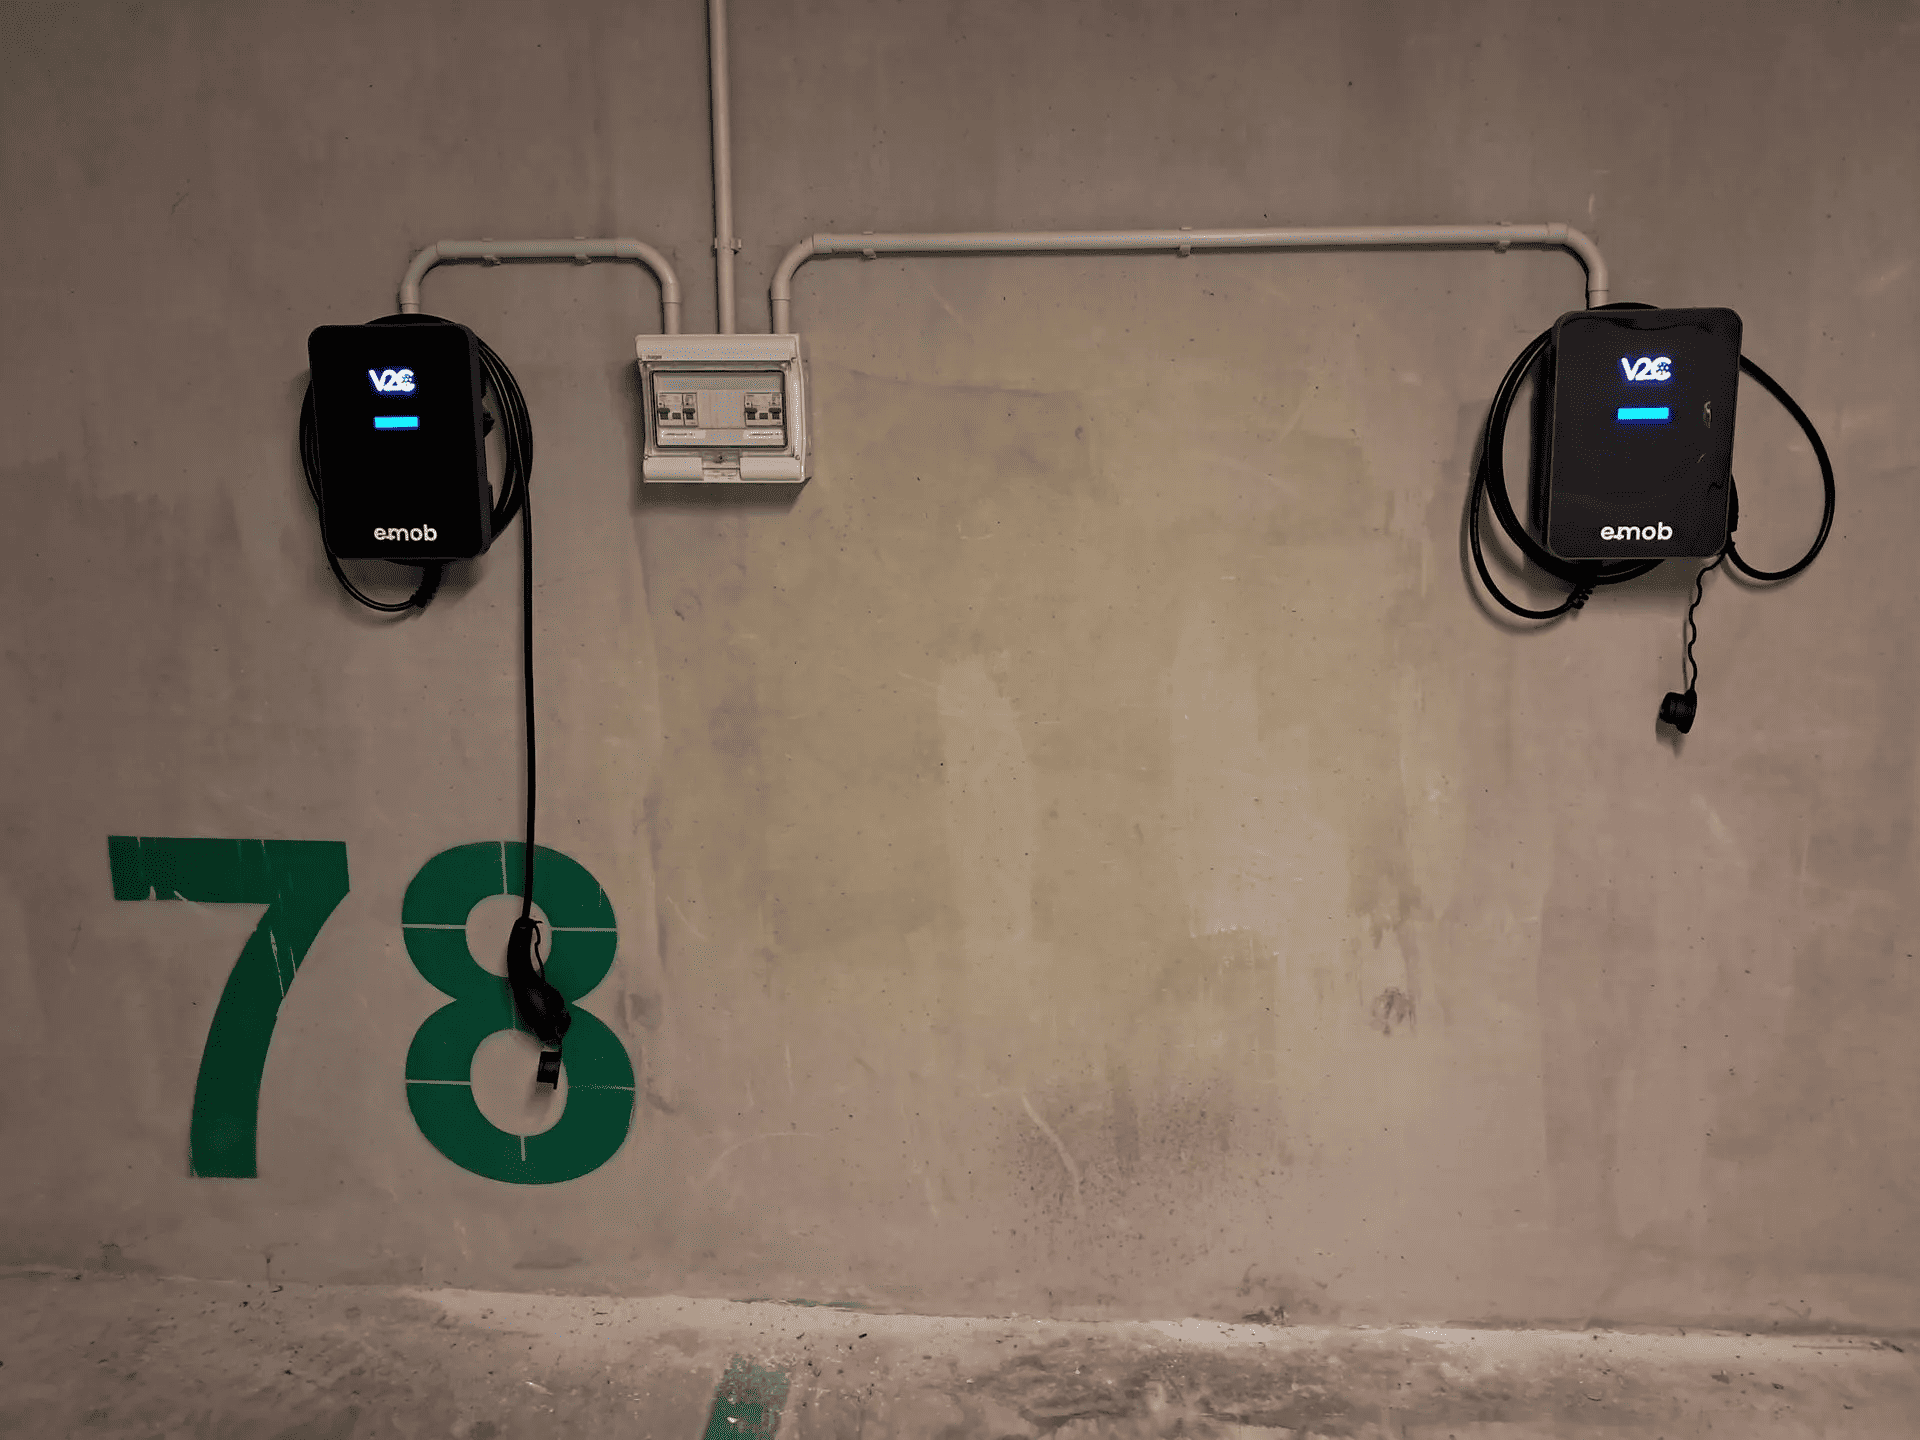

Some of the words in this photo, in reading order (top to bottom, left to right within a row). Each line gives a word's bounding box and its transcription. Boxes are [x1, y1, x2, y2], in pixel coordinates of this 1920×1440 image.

[1621, 356, 1672, 381] V2C
[368, 369, 415, 392] V2C
[373, 523, 438, 542] emob
[1600, 521, 1673, 541] emob
[107, 835, 635, 1186] 78
